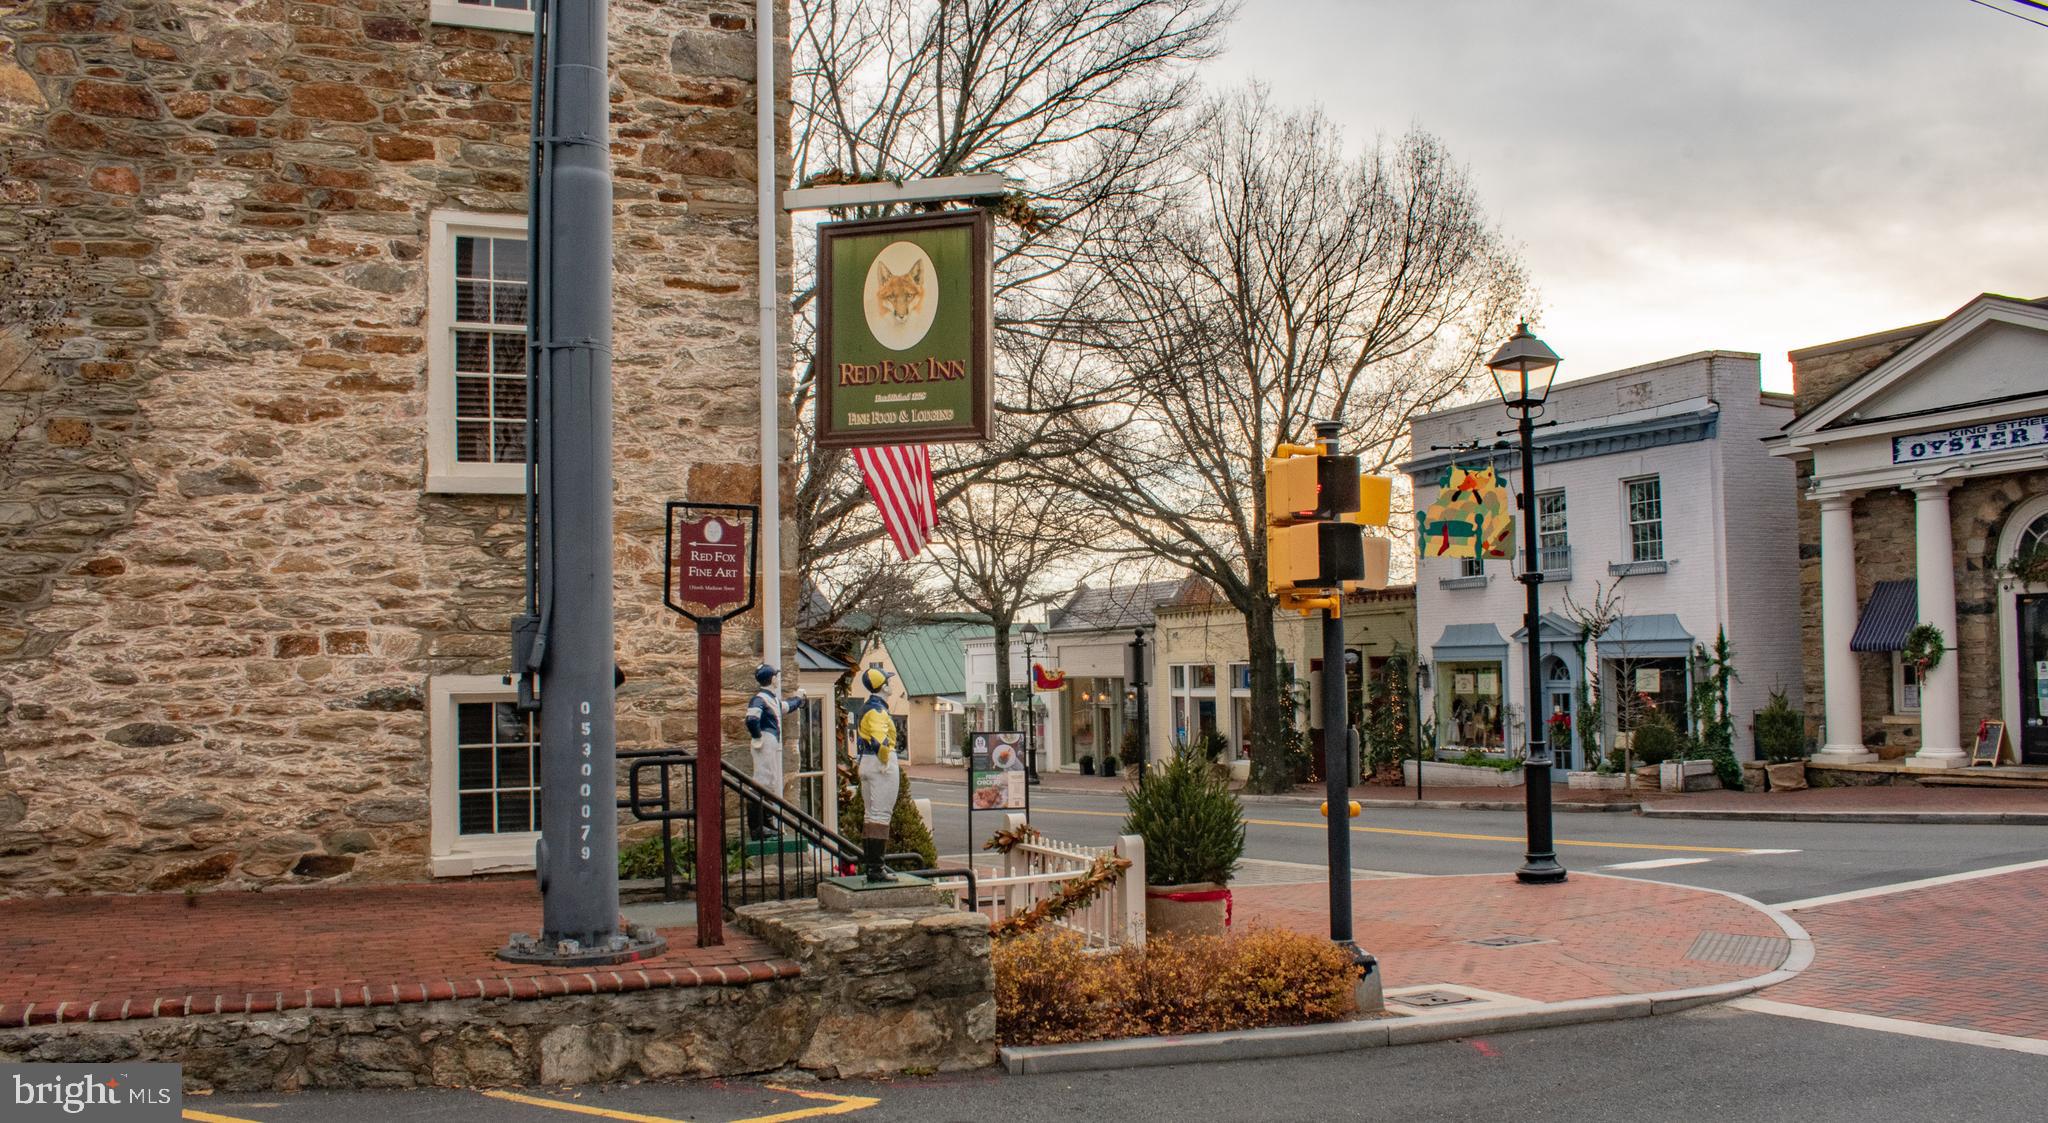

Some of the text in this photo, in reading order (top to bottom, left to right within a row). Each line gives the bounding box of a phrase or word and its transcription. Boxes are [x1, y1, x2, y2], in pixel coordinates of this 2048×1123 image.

[839, 356, 966, 387] RED FOX INN
[848, 411, 871, 425] FINE
[871, 410, 897, 424] FOOD
[898, 409, 909, 423] &
[1949, 426, 1988, 437] KING
[1910, 428, 2030, 457] OYSTER
[691, 551, 736, 562] RED FOX
[689, 566, 737, 578] FINE ART
